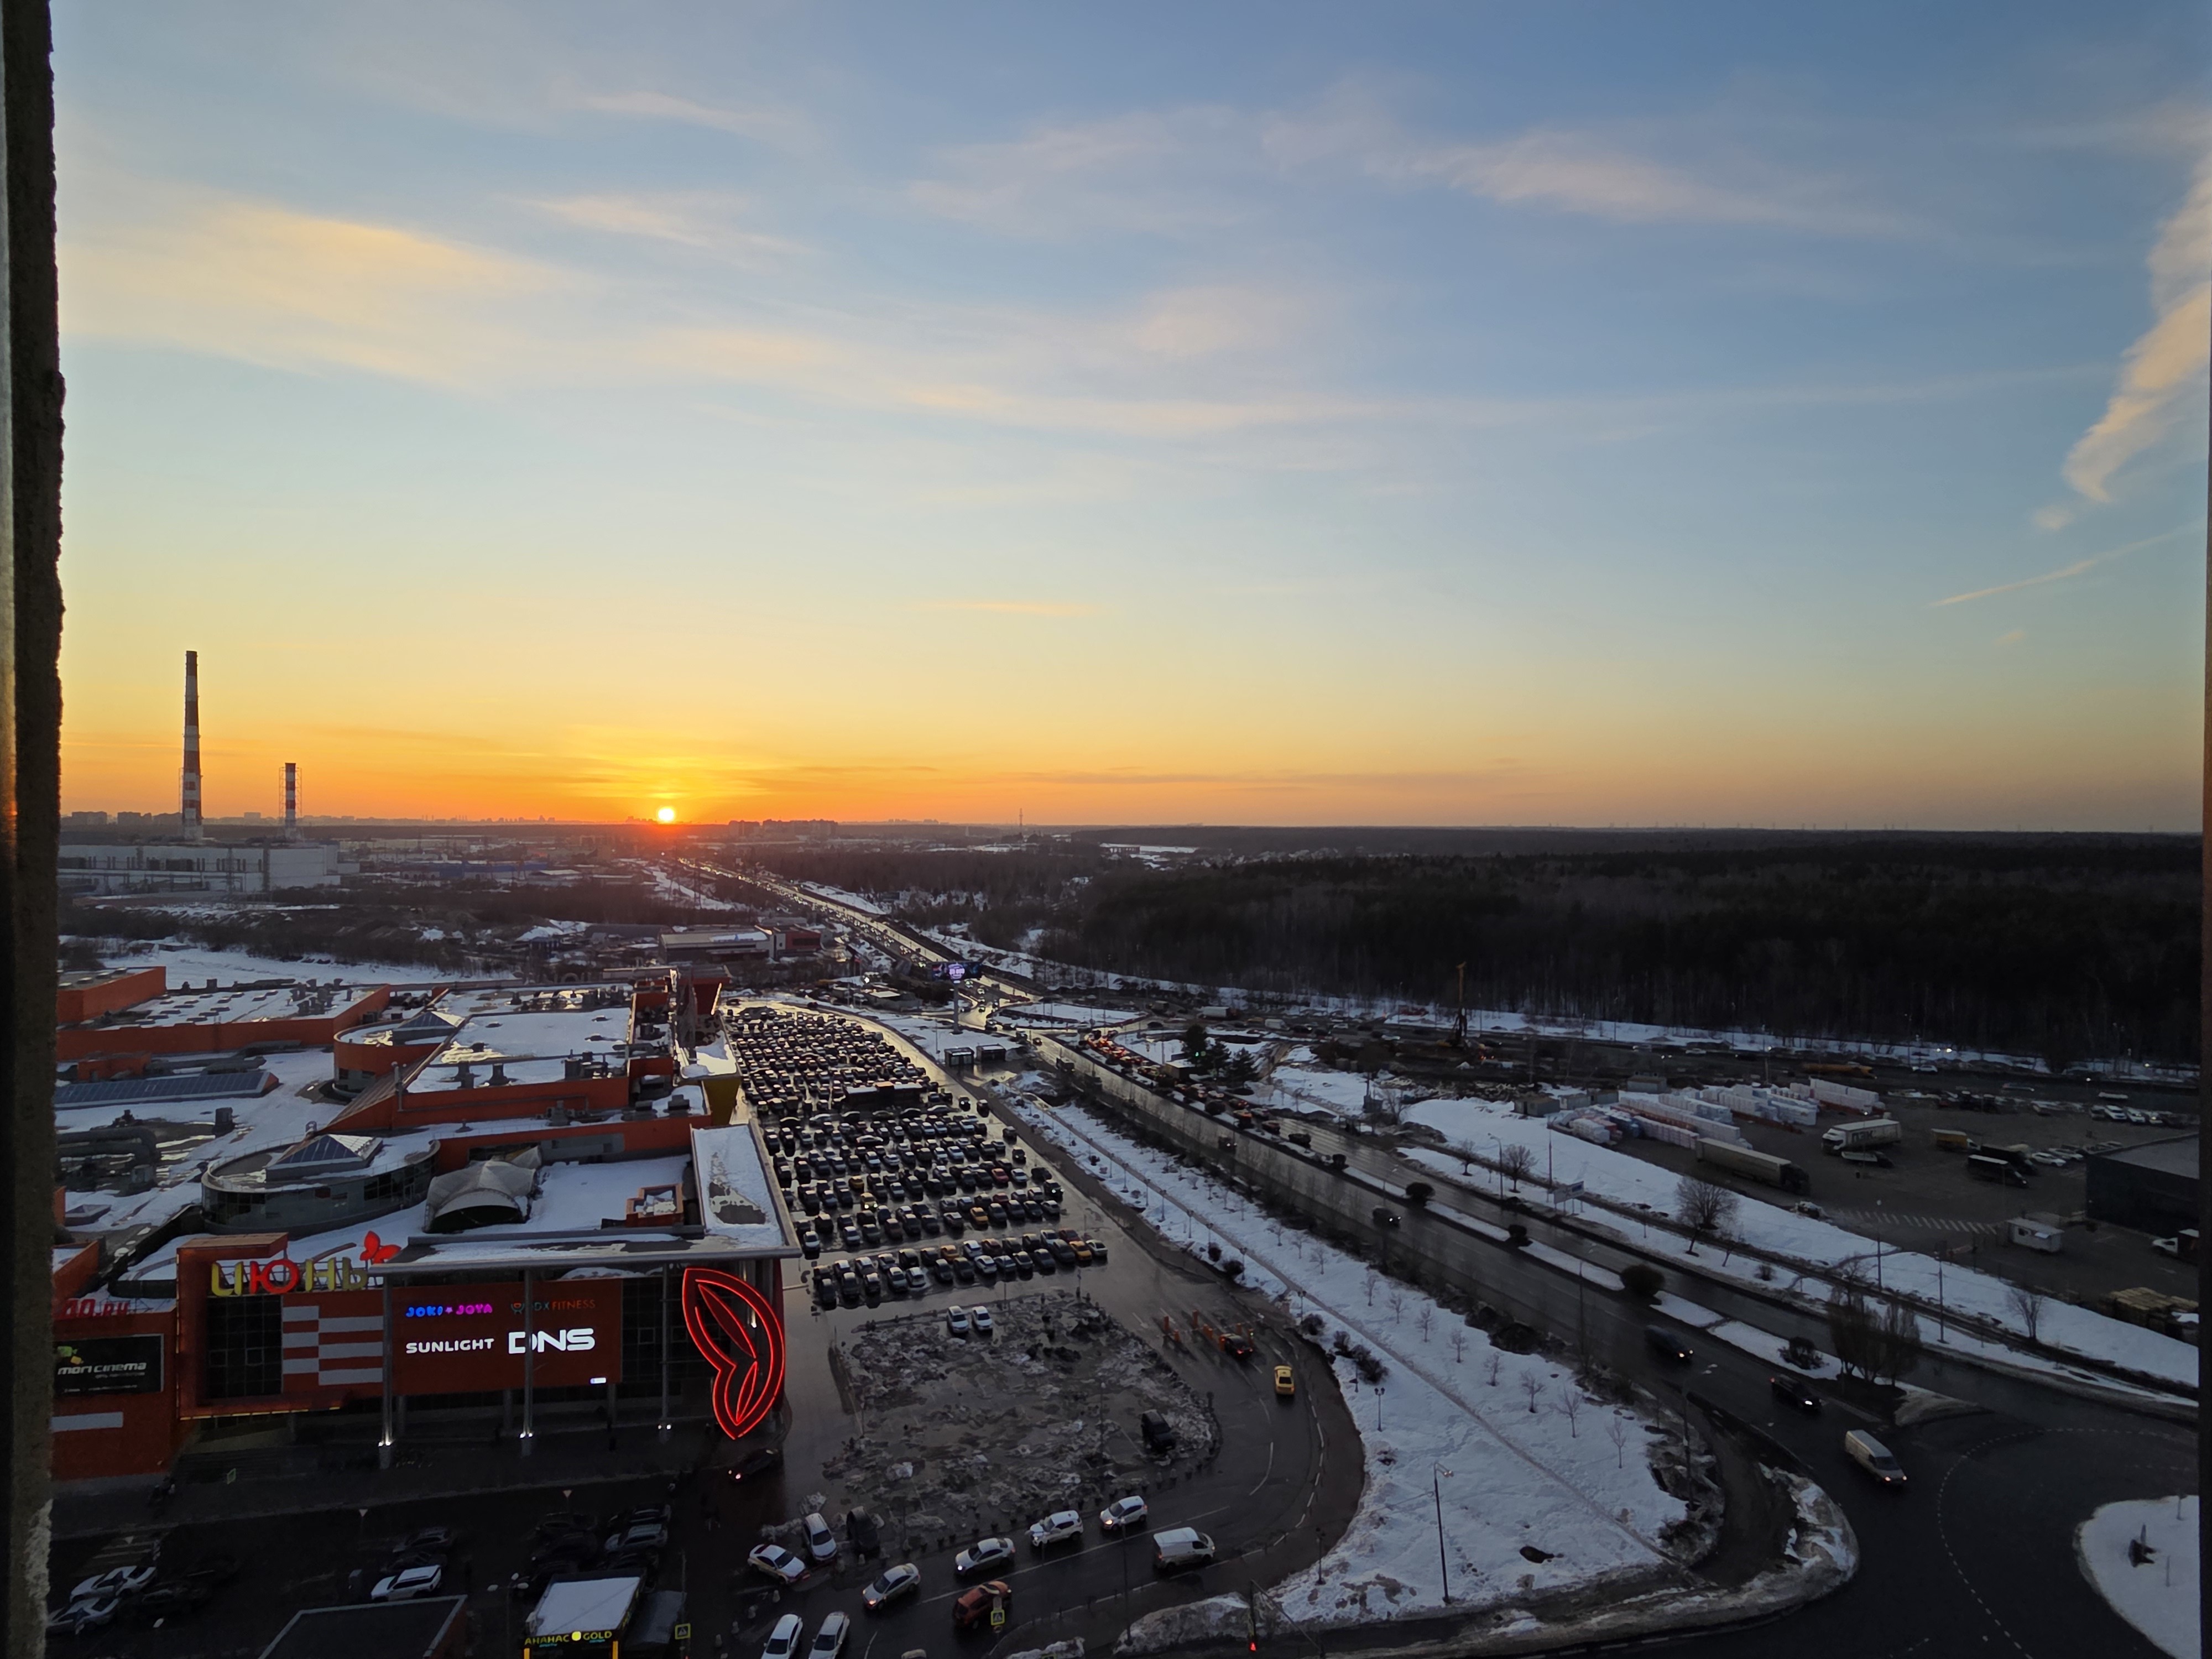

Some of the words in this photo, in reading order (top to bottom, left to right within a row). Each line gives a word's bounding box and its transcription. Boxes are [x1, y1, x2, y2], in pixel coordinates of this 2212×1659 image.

[405, 1305, 443, 1317] JOKI
[456, 1303, 493, 1315] JOYA
[551, 1299, 596, 1310] FITNESS
[405, 1338, 495, 1354] SUNLIGHT
[508, 1328, 596, 1354] DNS
[524, 1634, 570, 1646] АНАНАС
[583, 1630, 613, 1641] GOLD
